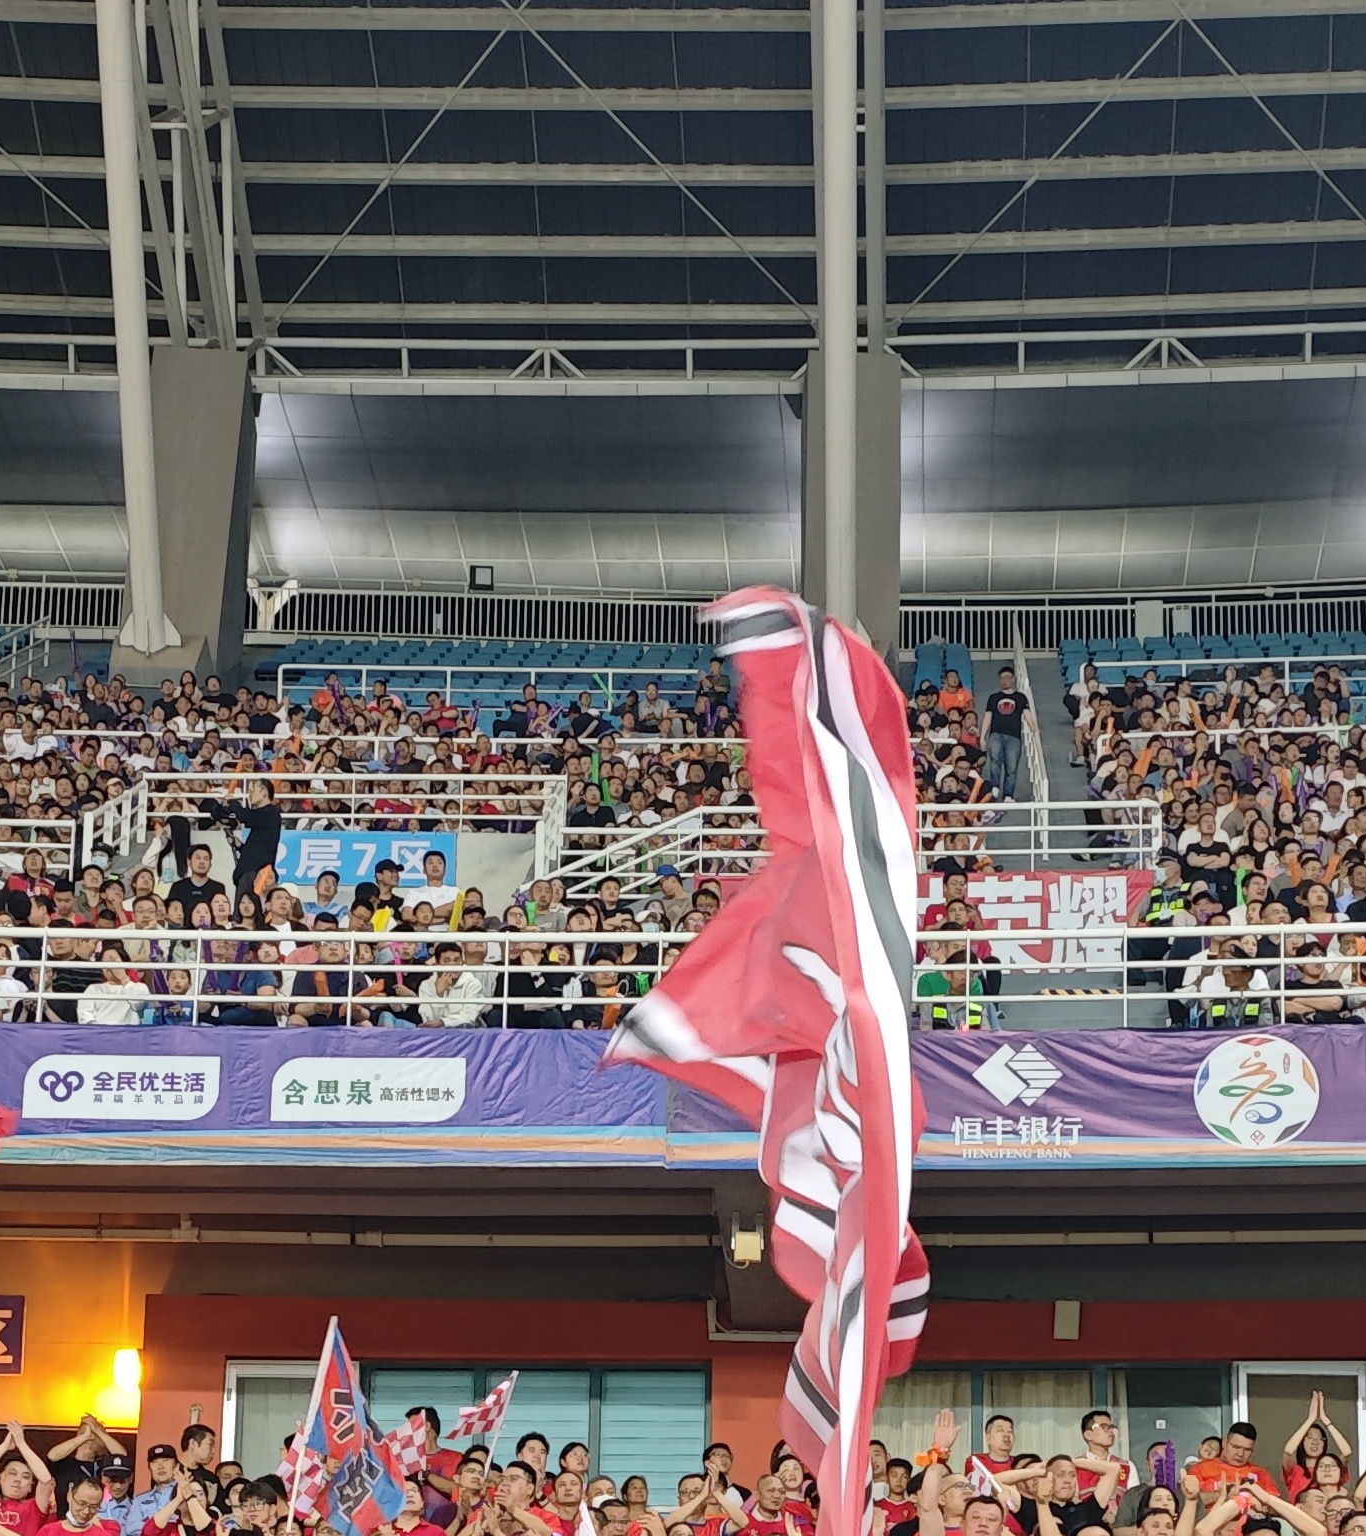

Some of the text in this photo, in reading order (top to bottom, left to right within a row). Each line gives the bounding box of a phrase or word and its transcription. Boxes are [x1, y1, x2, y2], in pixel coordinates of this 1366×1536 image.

[92, 1071, 206, 1093] 全民优生活
[281, 1078, 373, 1106] 含思泉
[950, 1115, 1084, 1147] 恒丰银行
[961, 1147, 1073, 1159] HENGFENG BANK
